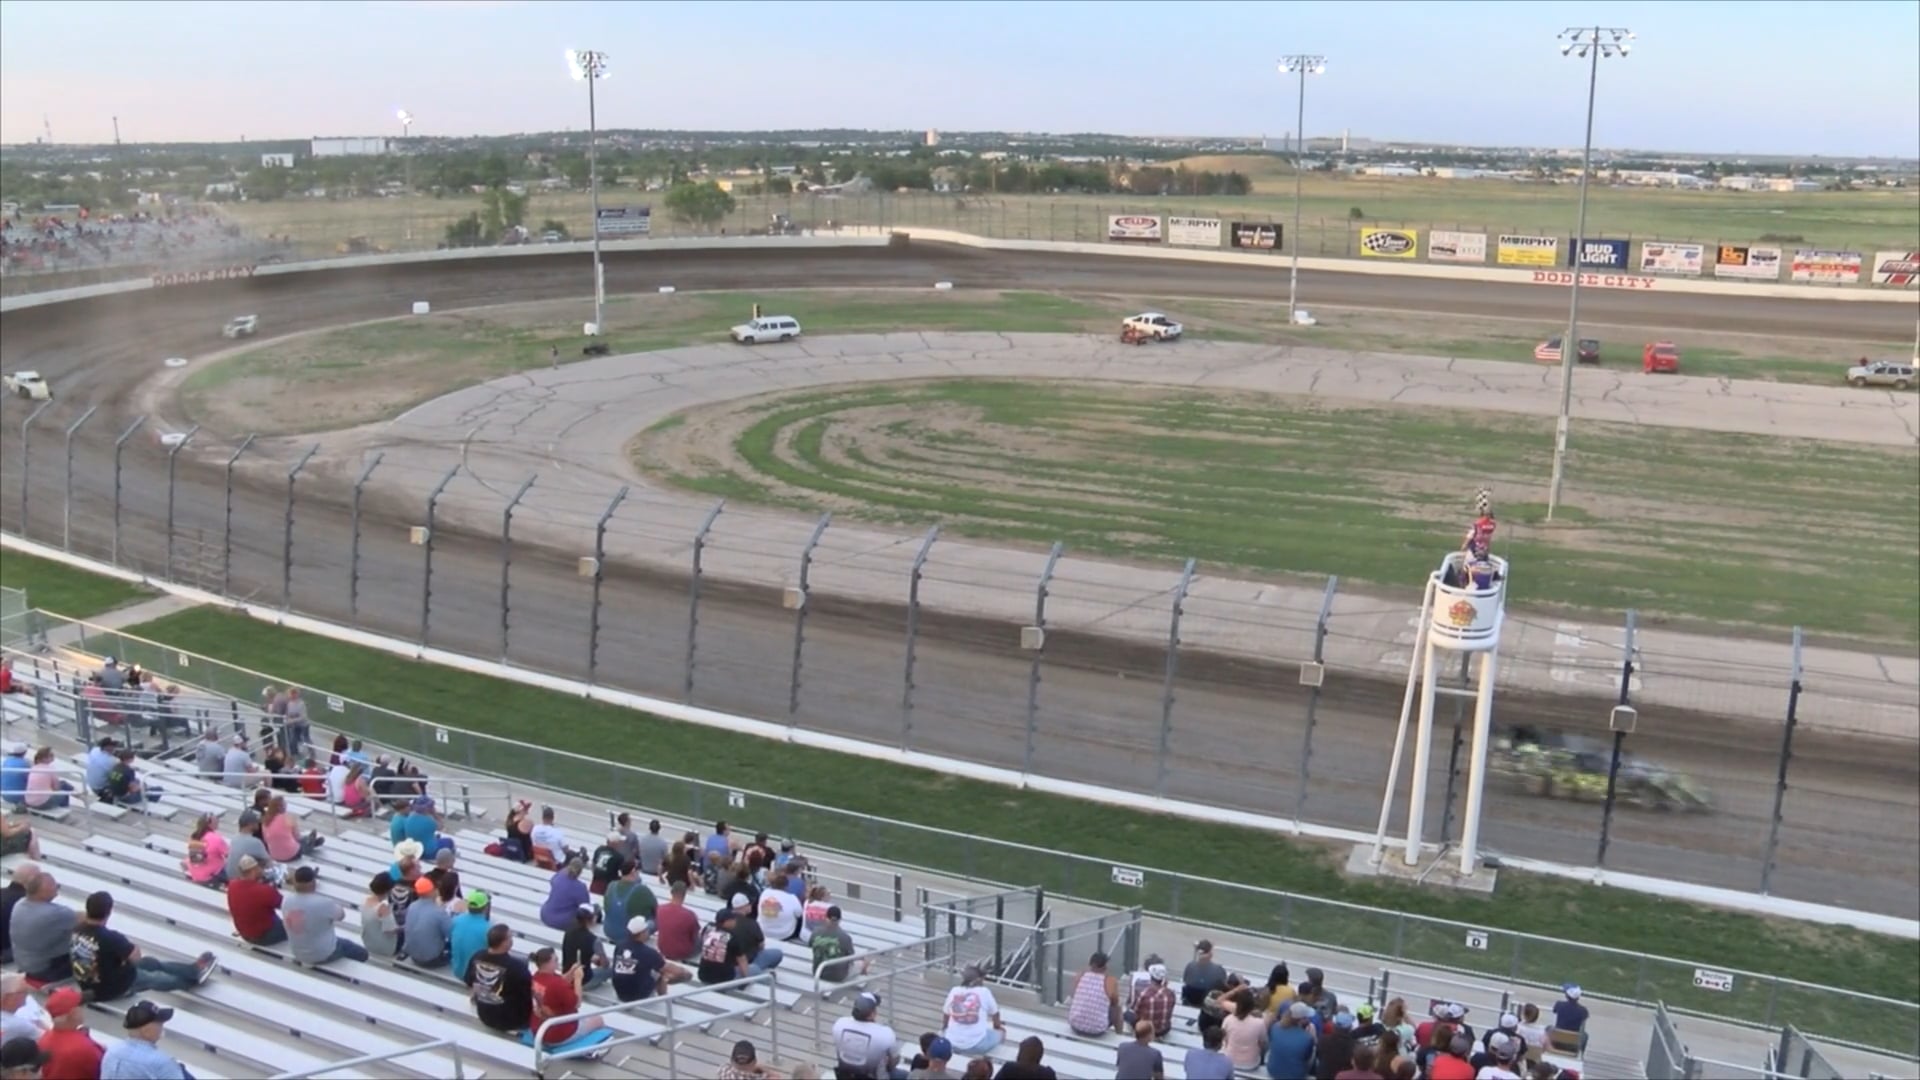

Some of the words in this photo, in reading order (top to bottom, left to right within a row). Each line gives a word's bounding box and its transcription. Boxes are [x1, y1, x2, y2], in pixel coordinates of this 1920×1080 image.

[1585, 243, 1613, 254] BUD
[1580, 252, 1618, 264] LIGHT
[1604, 275, 1656, 289] CITY
